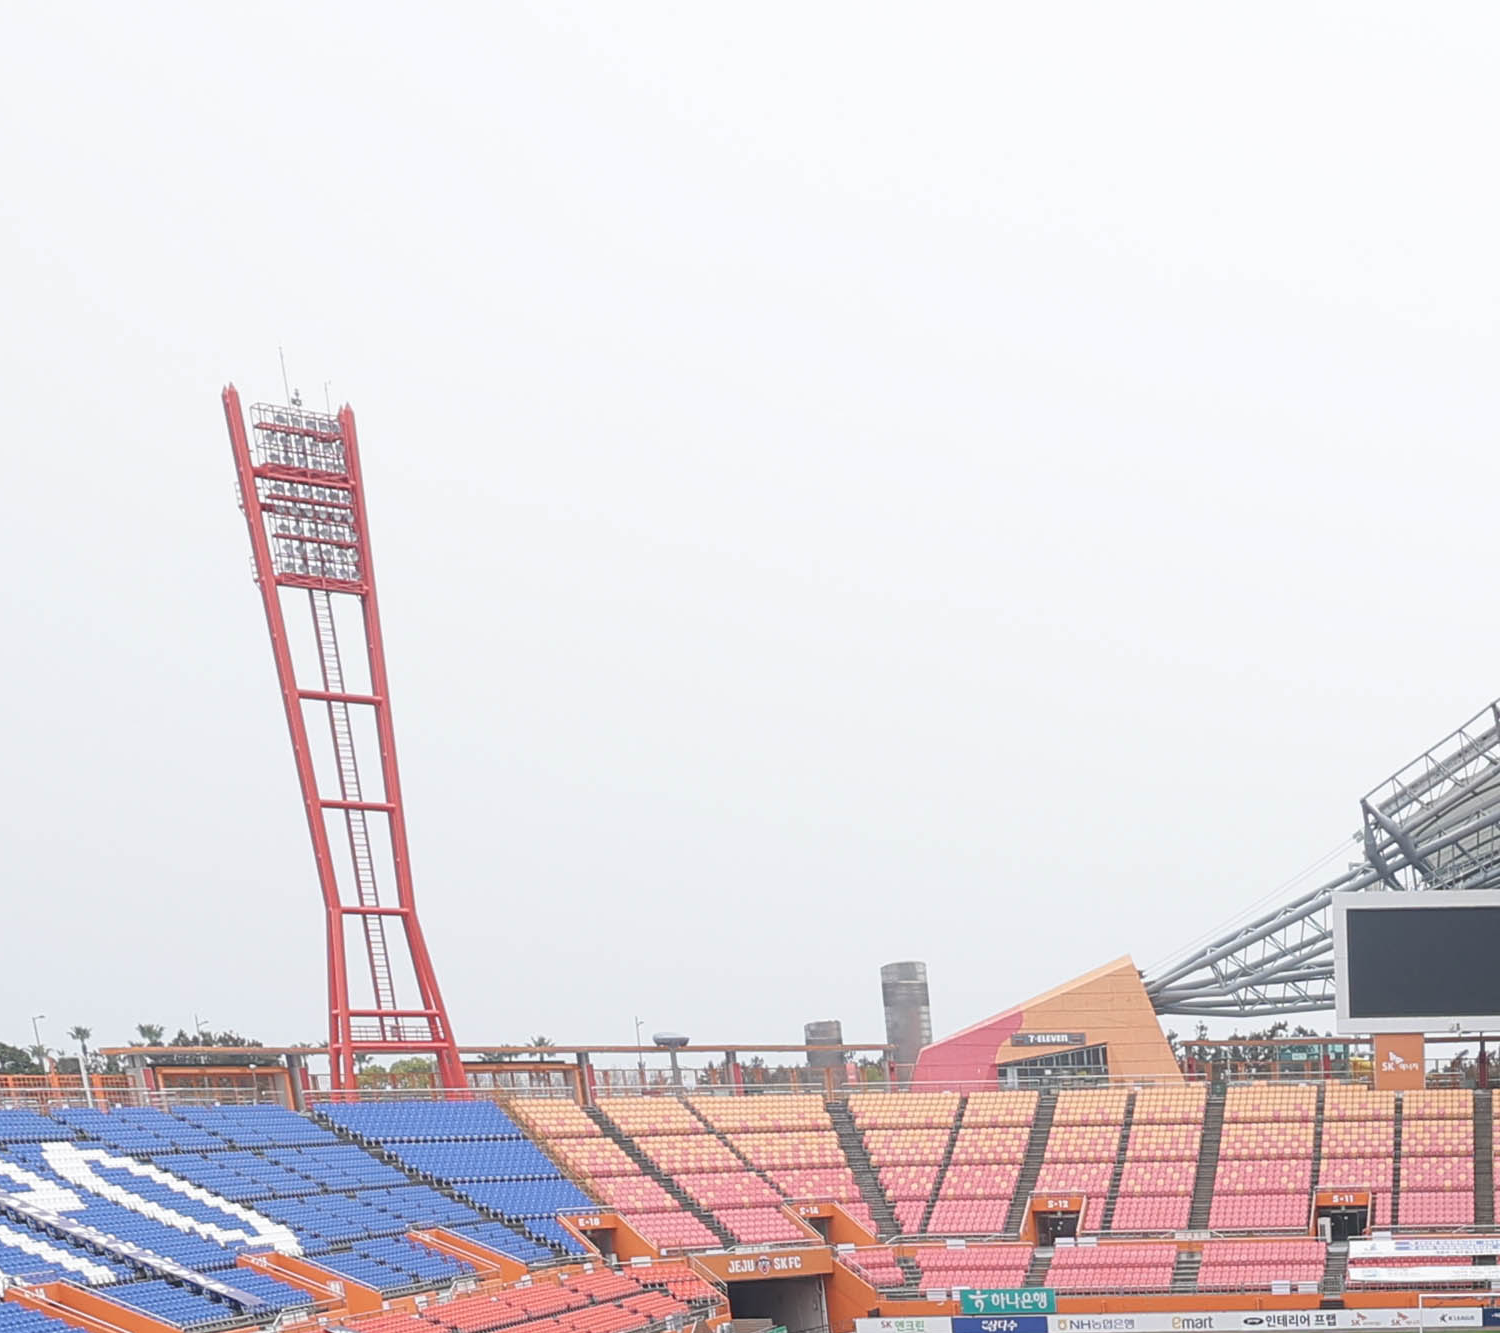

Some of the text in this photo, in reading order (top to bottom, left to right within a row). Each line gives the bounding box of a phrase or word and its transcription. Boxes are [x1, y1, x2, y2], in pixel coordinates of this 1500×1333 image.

[728, 1256, 802, 1274] JEJU SK FC
[991, 1292, 1048, 1310] 하나은행
[880, 1320, 893, 1329] SK
[1172, 1315, 1213, 1329] emart
[1265, 1314, 1311, 1327] 인테리어
